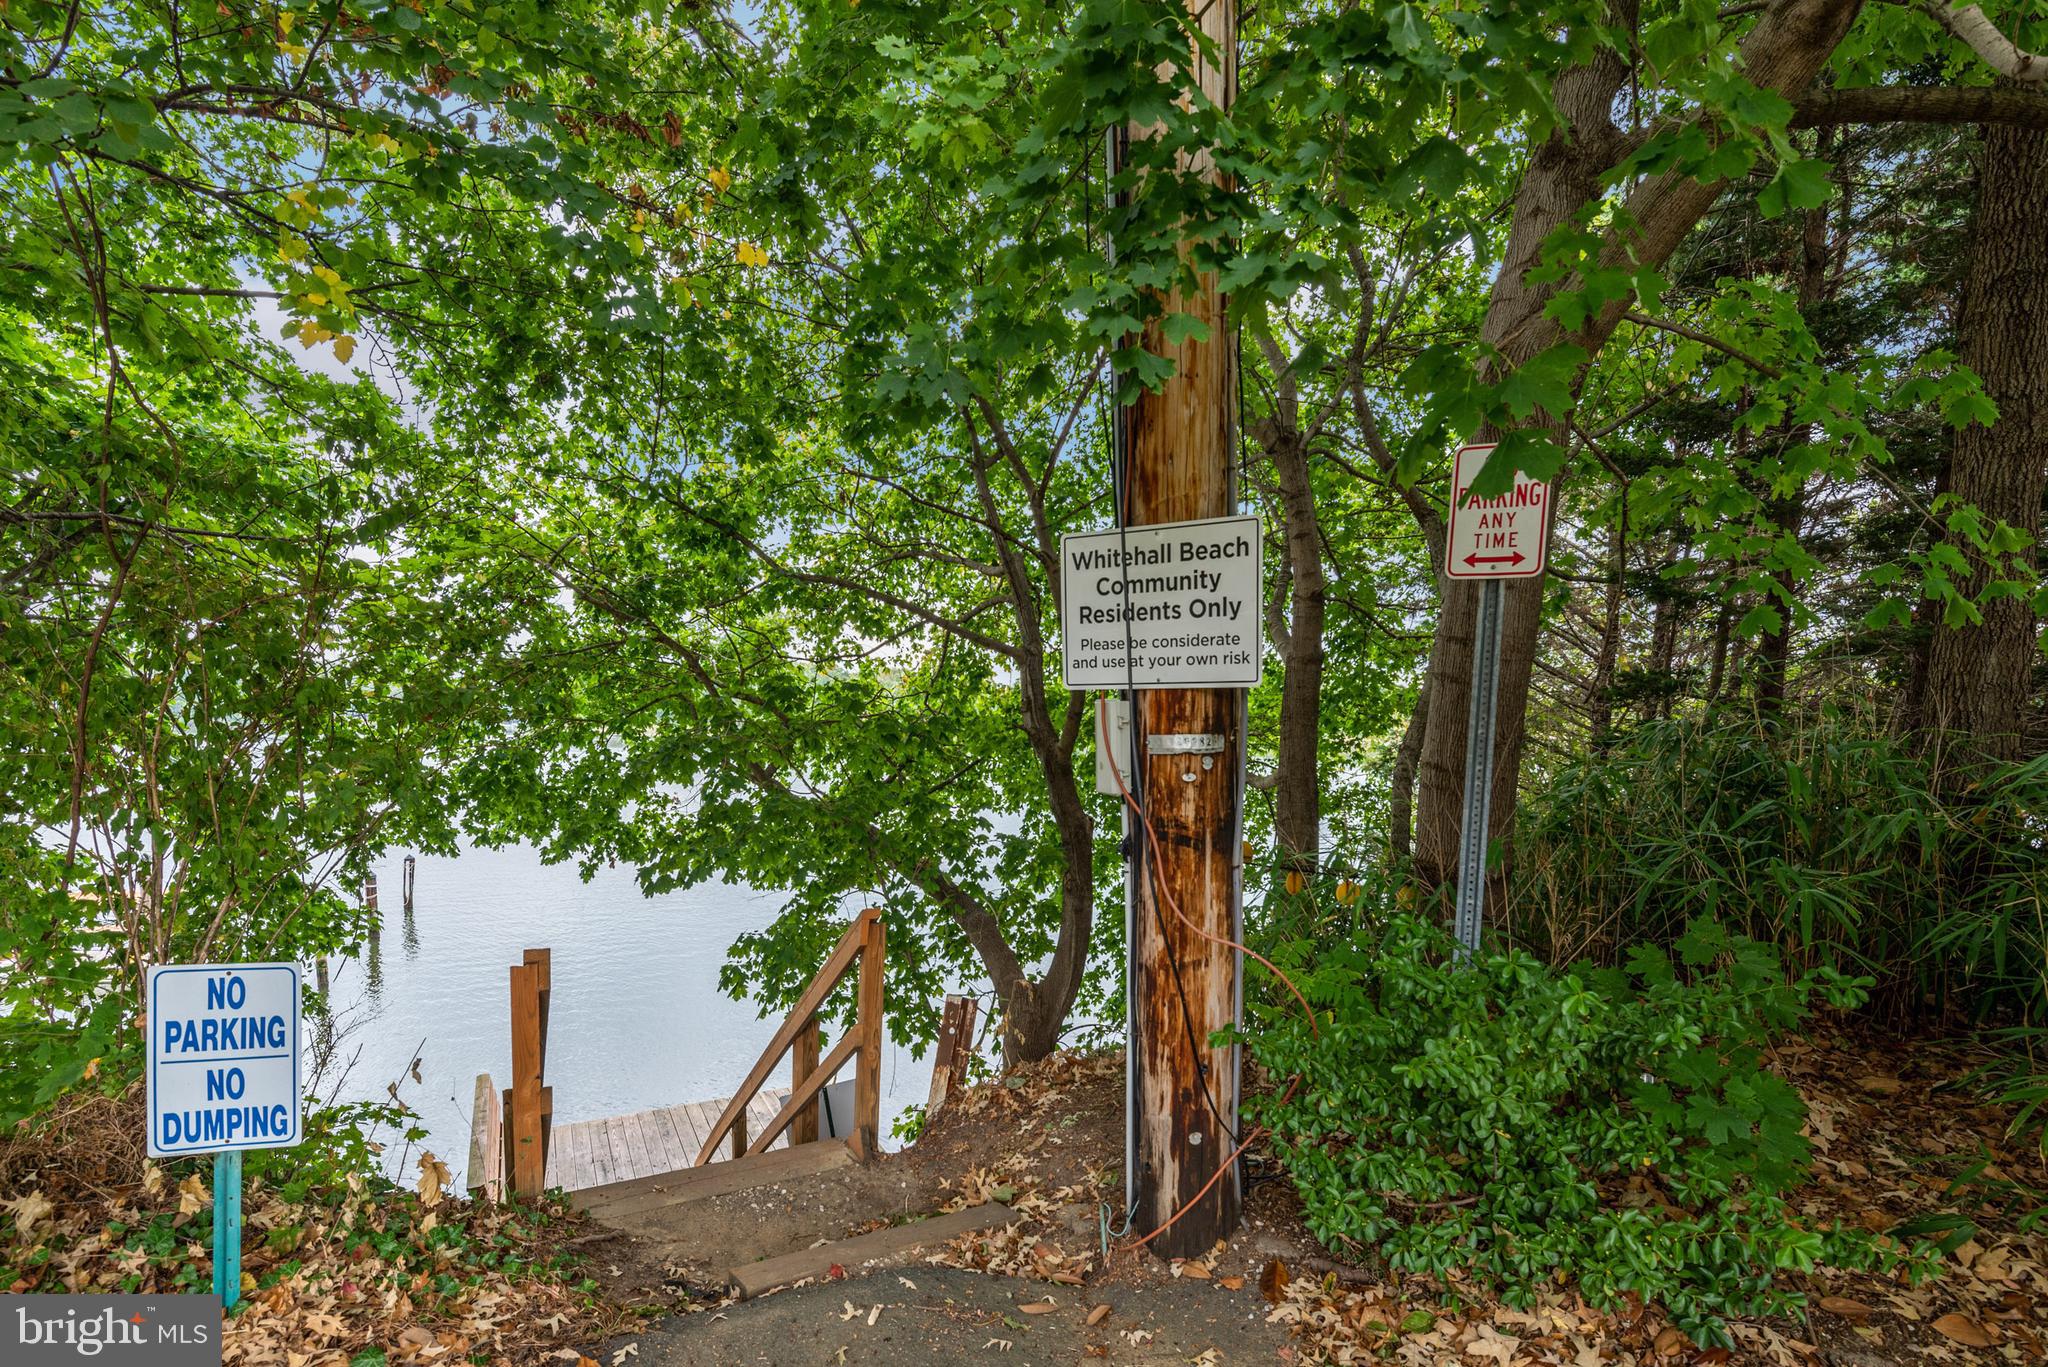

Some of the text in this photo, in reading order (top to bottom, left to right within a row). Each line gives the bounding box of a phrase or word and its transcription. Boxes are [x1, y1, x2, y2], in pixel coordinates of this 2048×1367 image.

[1479, 511, 1517, 529] ANY
[1071, 536, 1249, 571] Whitehall Beach
[1474, 531, 1518, 549] TIME
[1096, 569, 1222, 596] Community
[1079, 596, 1242, 625] Residents Only
[1081, 632, 1241, 651] Please be considerate
[1072, 650, 1251, 670] and use at your own risk
[207, 976, 246, 1011] NO
[165, 1015, 286, 1054] PARKING
[206, 1067, 245, 1101] NO
[162, 1104, 288, 1145] DUMPING
